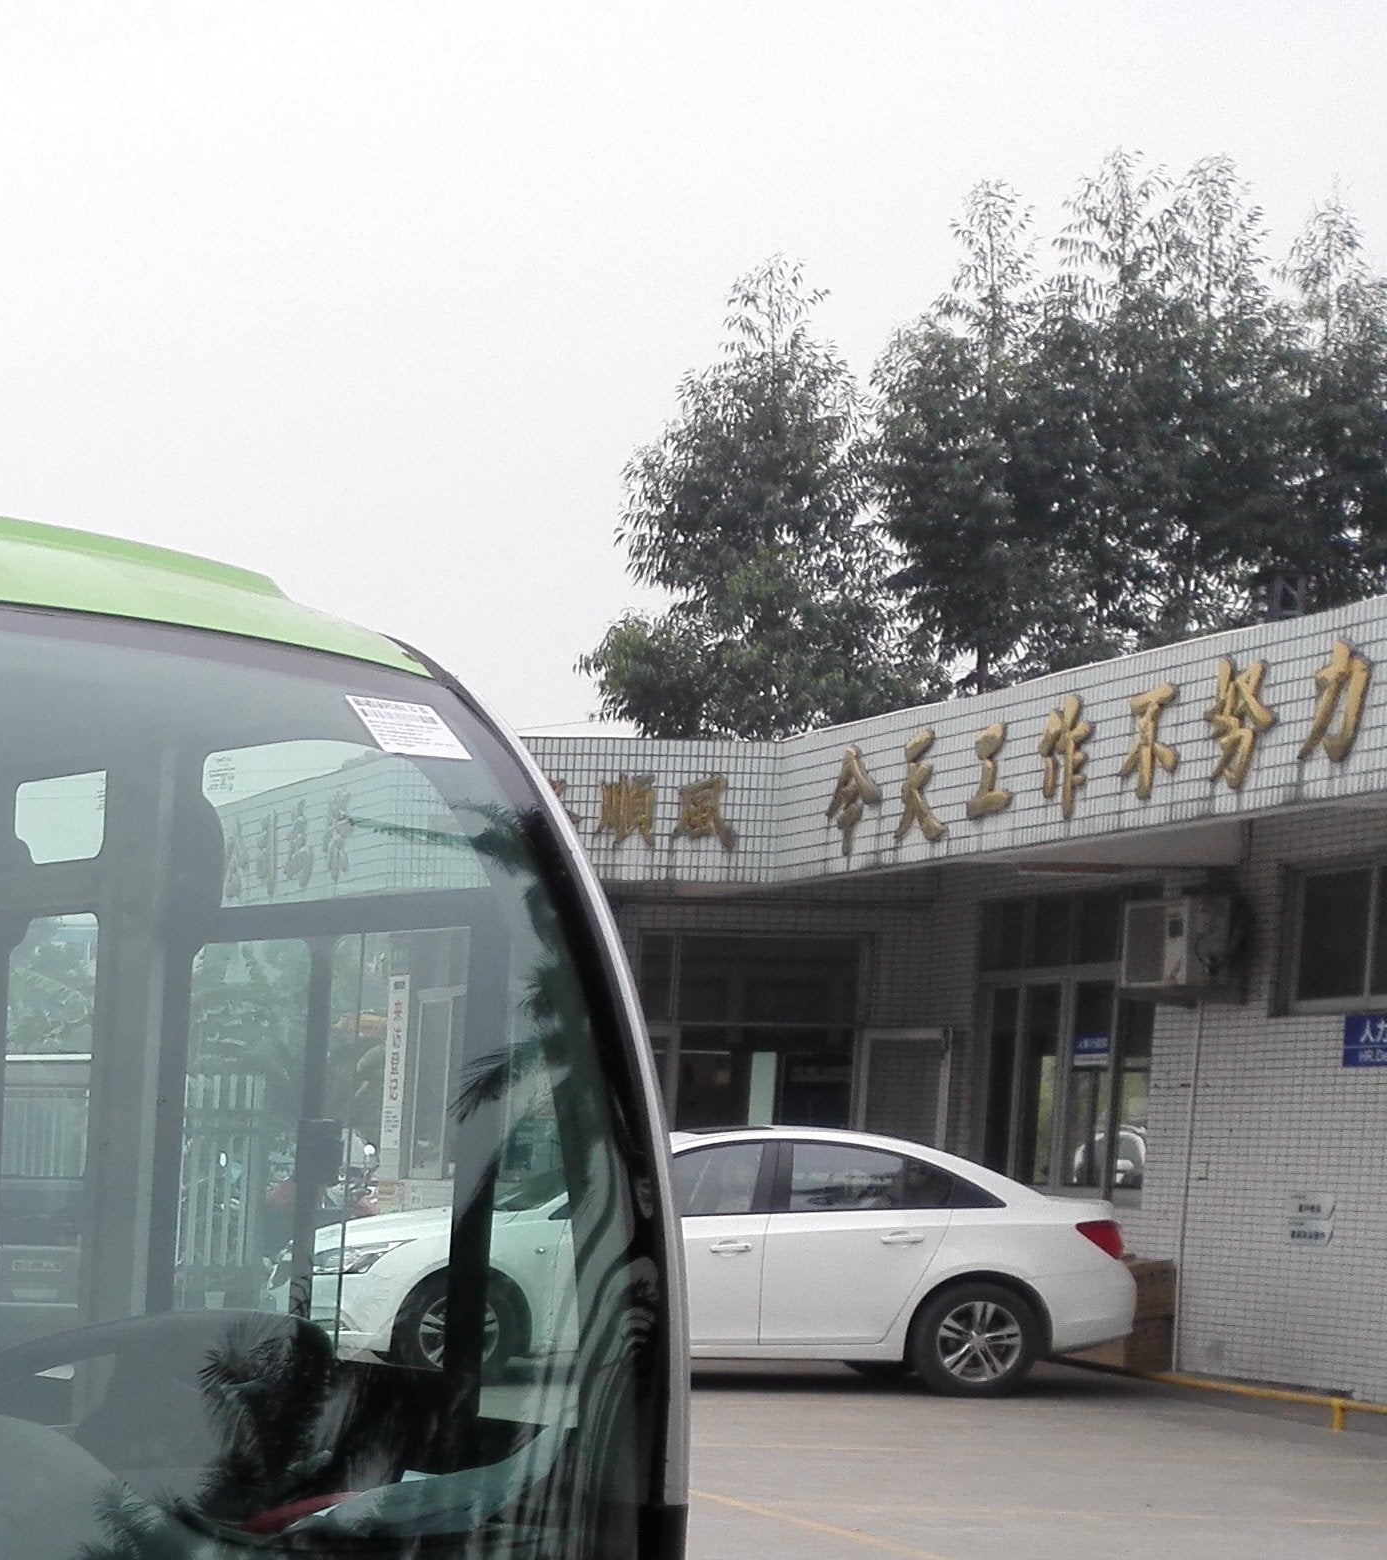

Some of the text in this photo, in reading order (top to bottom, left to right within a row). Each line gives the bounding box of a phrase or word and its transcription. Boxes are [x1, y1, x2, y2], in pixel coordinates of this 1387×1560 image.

[549, 773, 738, 849] 順風
[826, 640, 1372, 857] 今天工作不努力
